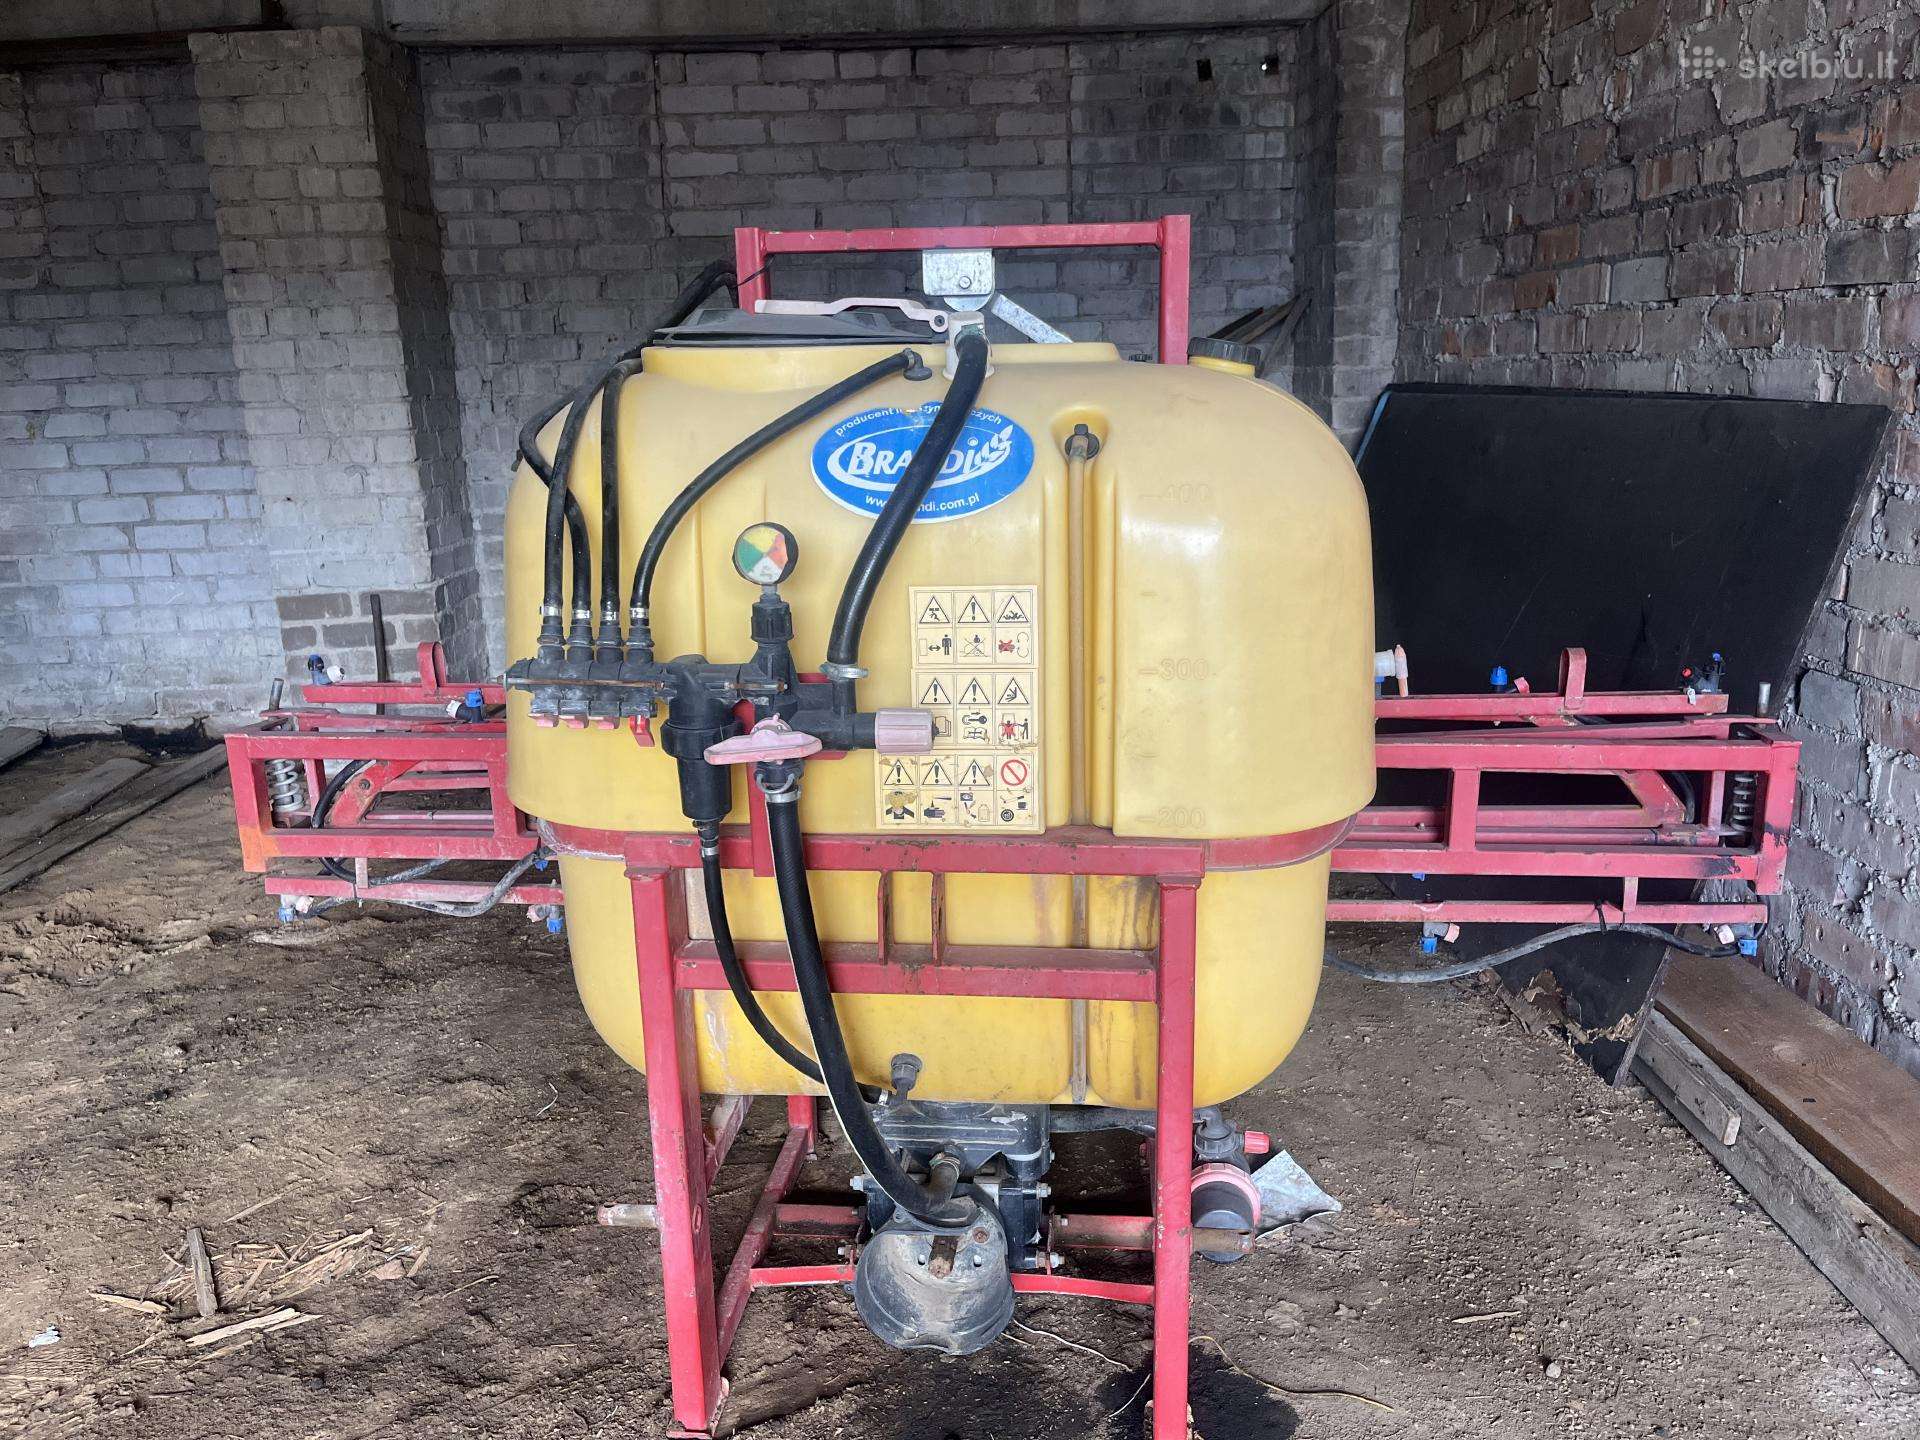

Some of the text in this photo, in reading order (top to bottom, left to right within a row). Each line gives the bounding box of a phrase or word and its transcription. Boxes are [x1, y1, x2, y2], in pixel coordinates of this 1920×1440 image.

[835, 407, 894, 436] producent
[1158, 657, 1209, 681] 300
[1157, 806, 1206, 830] 200
